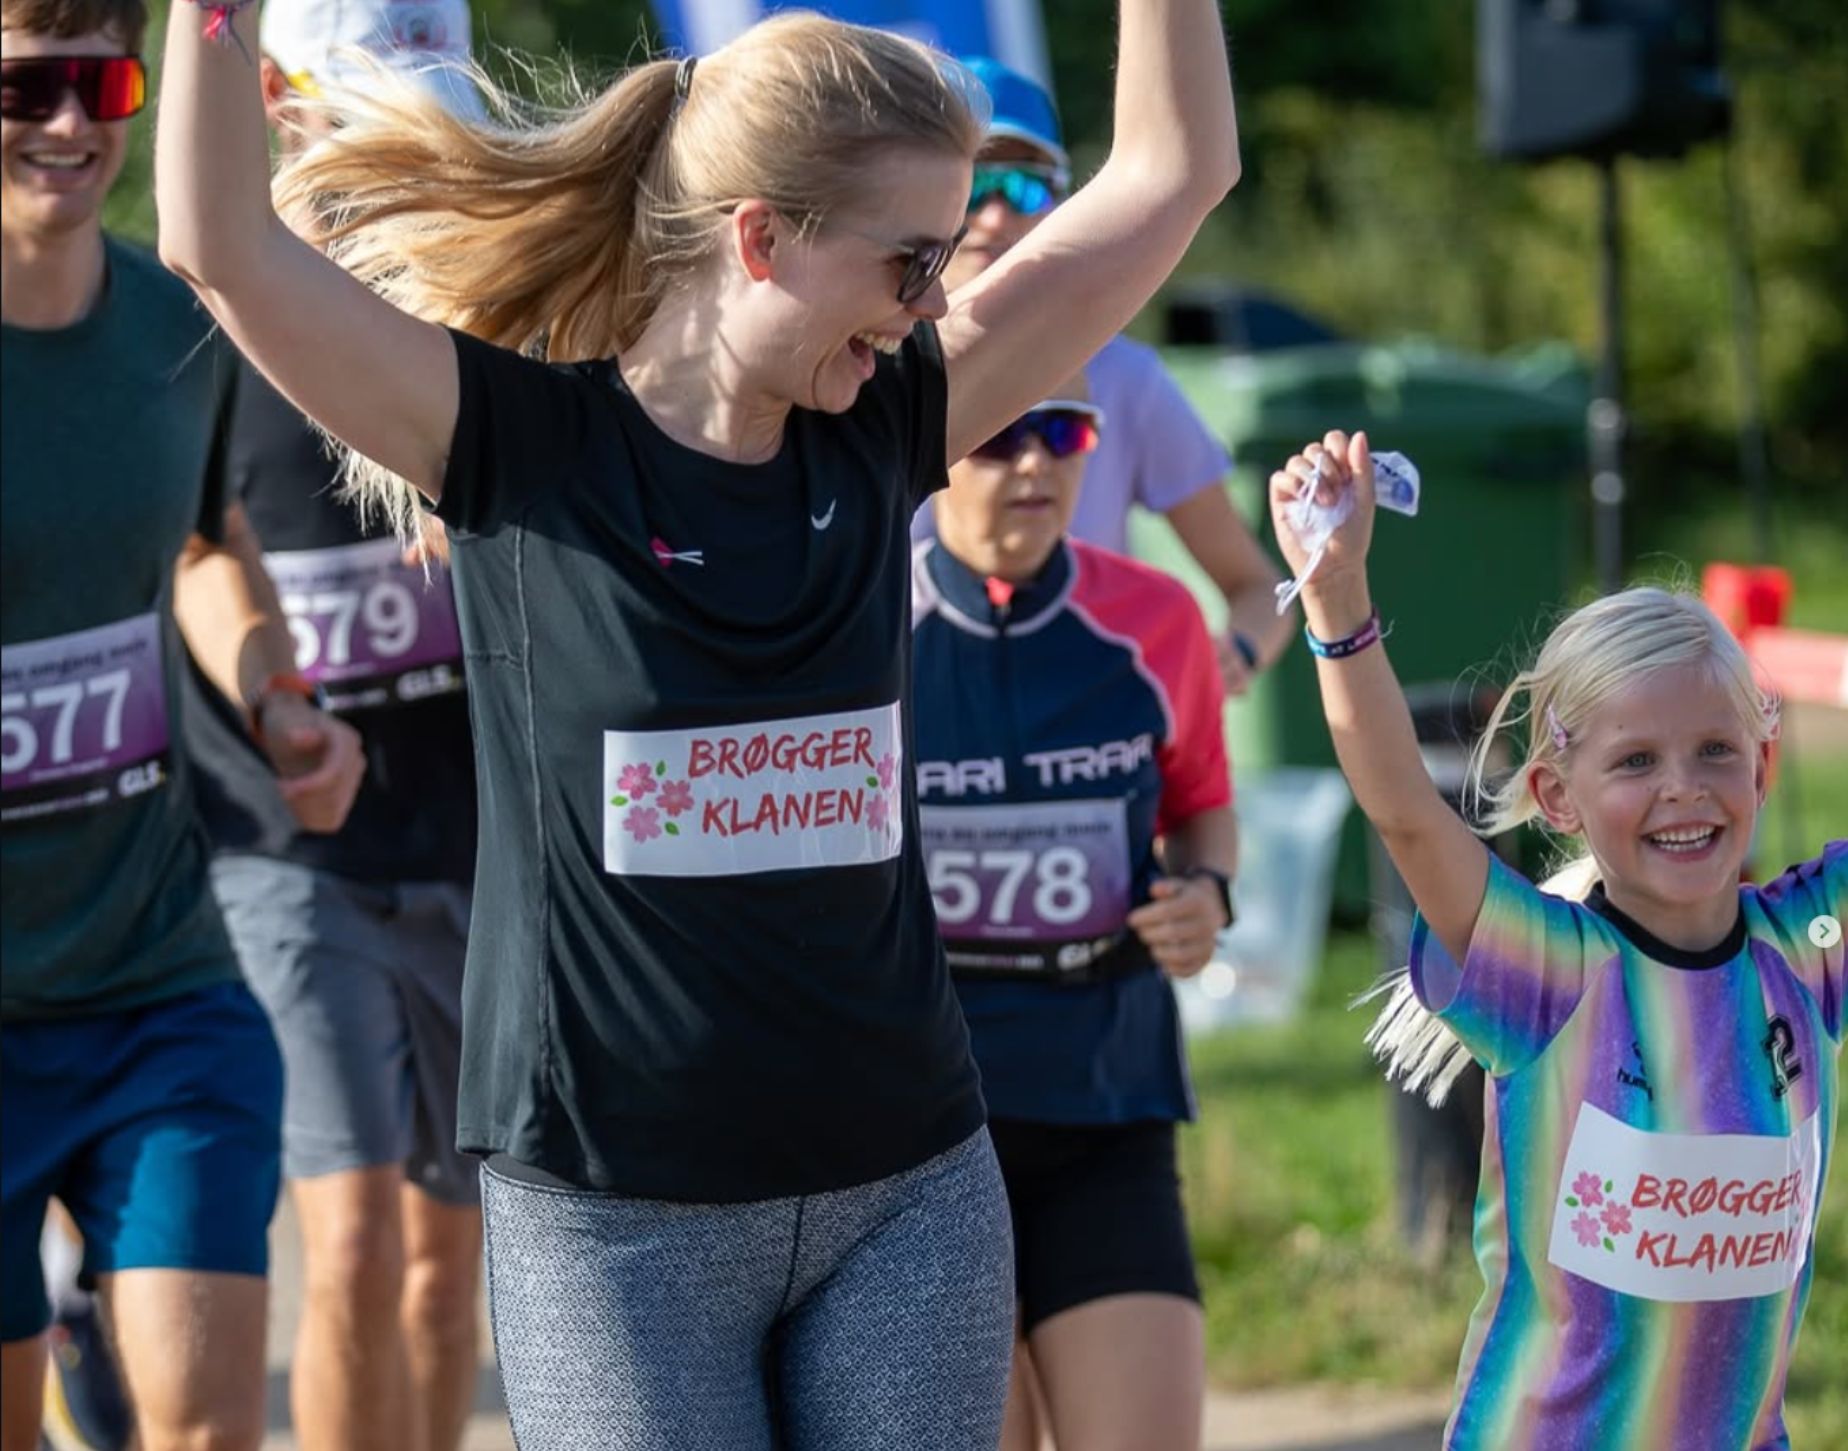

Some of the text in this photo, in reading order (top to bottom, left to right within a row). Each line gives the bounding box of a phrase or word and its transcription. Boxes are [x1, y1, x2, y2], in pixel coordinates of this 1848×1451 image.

[1, 670, 131, 775] 577
[688, 727, 875, 779] BRØGGER
[702, 788, 864, 838] KLANEN
[926, 846, 1093, 925] 578
[1632, 1169, 1802, 1218] BRØGGER
[1636, 1227, 1793, 1274] KLANEN
